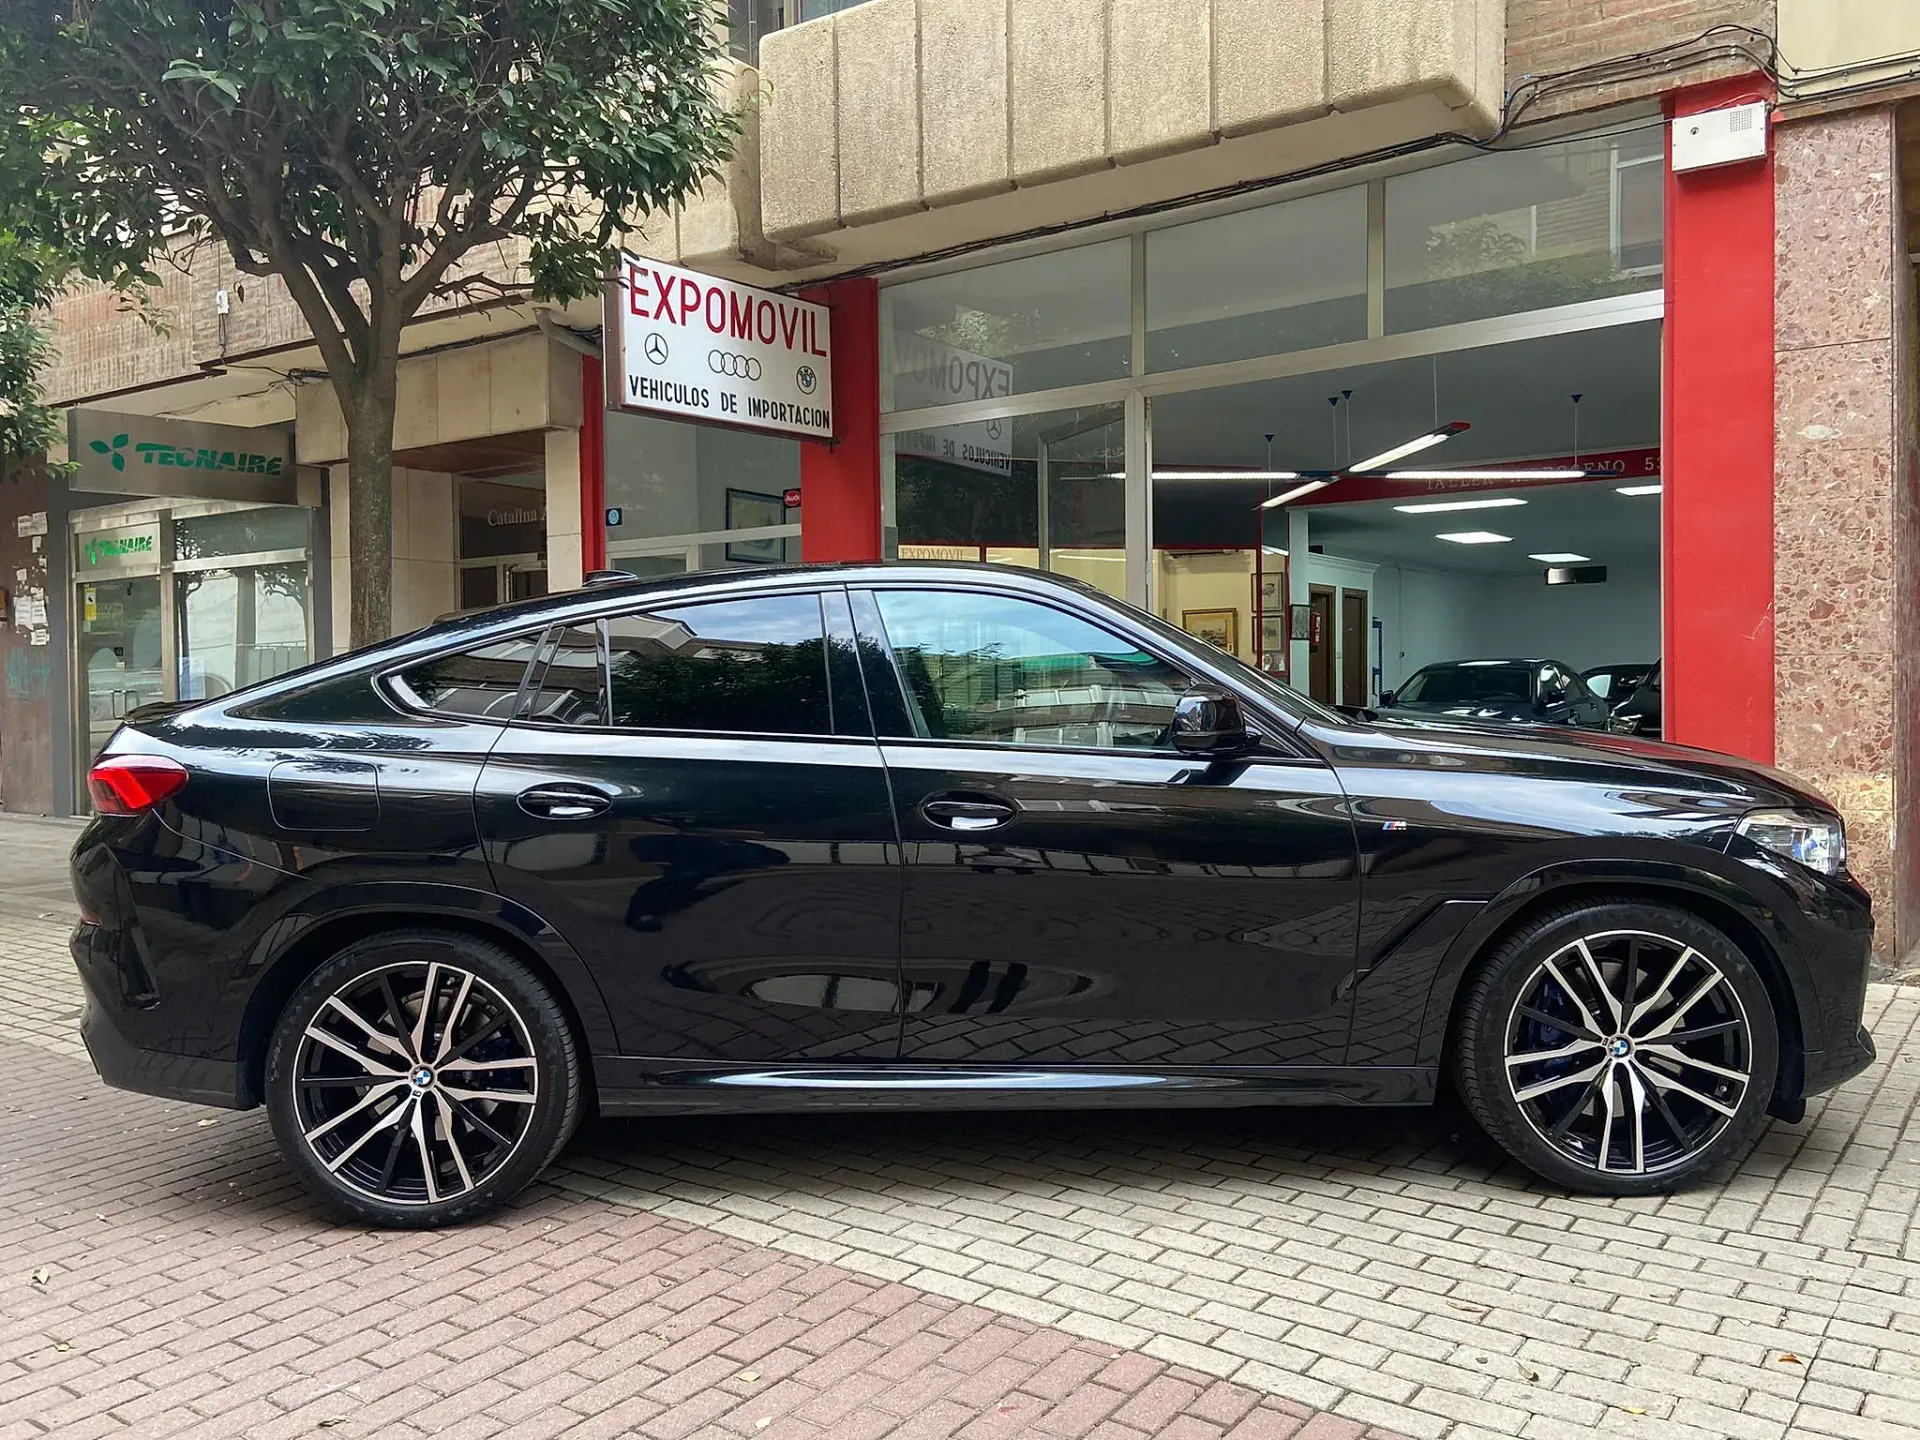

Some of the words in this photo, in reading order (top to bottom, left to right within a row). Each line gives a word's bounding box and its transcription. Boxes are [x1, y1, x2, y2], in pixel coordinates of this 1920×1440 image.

[629, 264, 827, 358] EXPOMOVIL
[629, 374, 710, 408] VEHICULOS
[720, 391, 738, 414] DE
[748, 396, 830, 429] IMPORTACION
[135, 442, 282, 476] TECNAIRE
